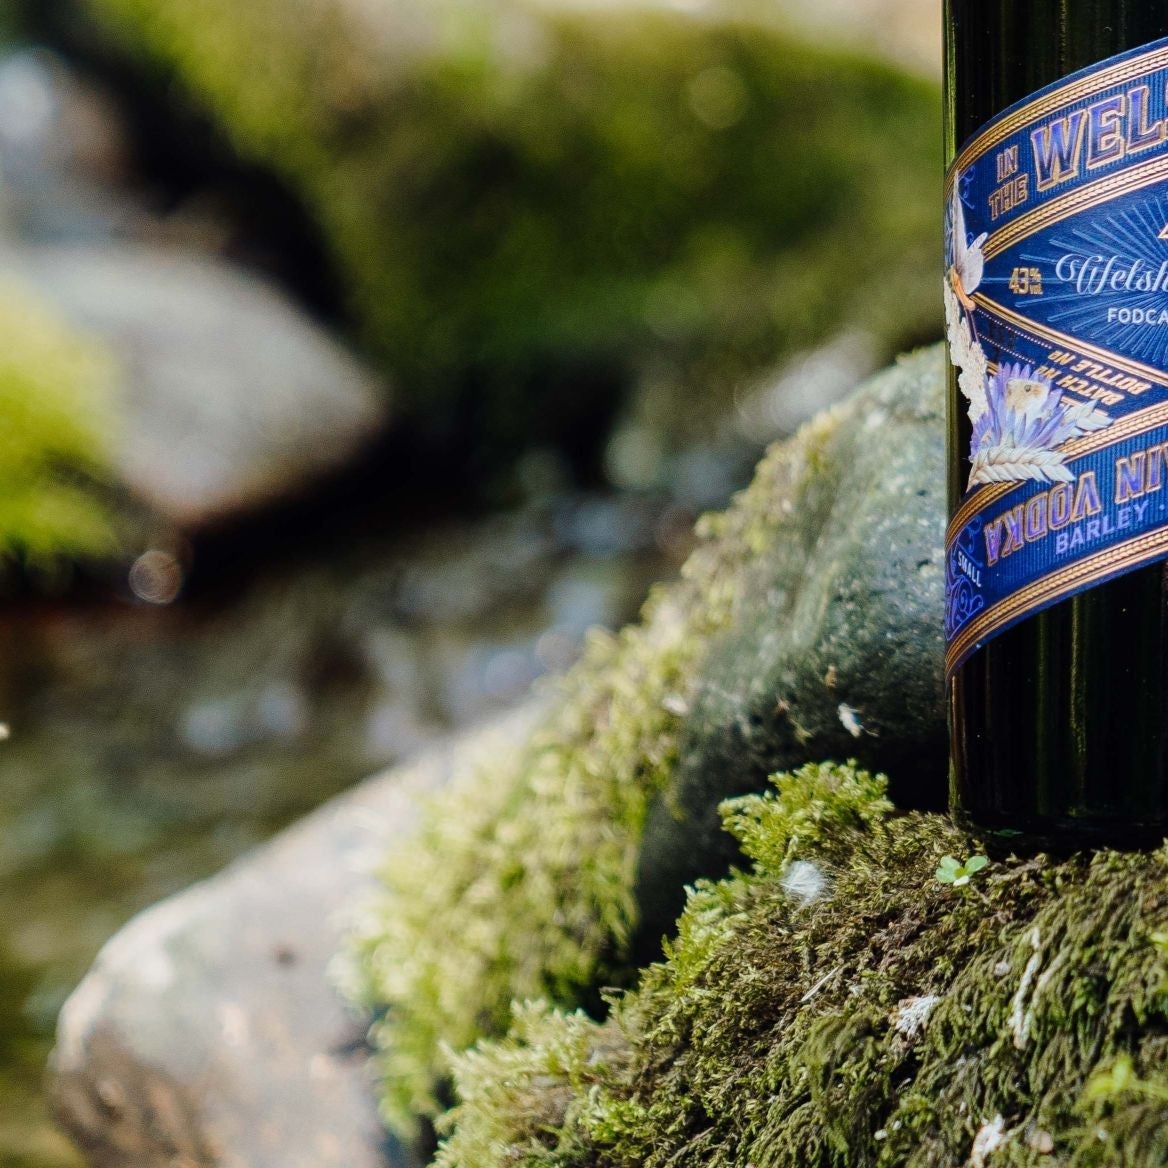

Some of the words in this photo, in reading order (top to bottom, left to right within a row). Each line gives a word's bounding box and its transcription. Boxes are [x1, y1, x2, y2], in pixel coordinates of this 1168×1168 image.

[996, 145, 1019, 183] IN
[988, 173, 1028, 221] THE
[1056, 374, 1126, 406] BATCH
[1069, 359, 1153, 395] BOTTLE
[983, 470, 1102, 568] VODKA
[1054, 499, 1149, 555] BARLEY
[957, 550, 982, 588] SMALL
